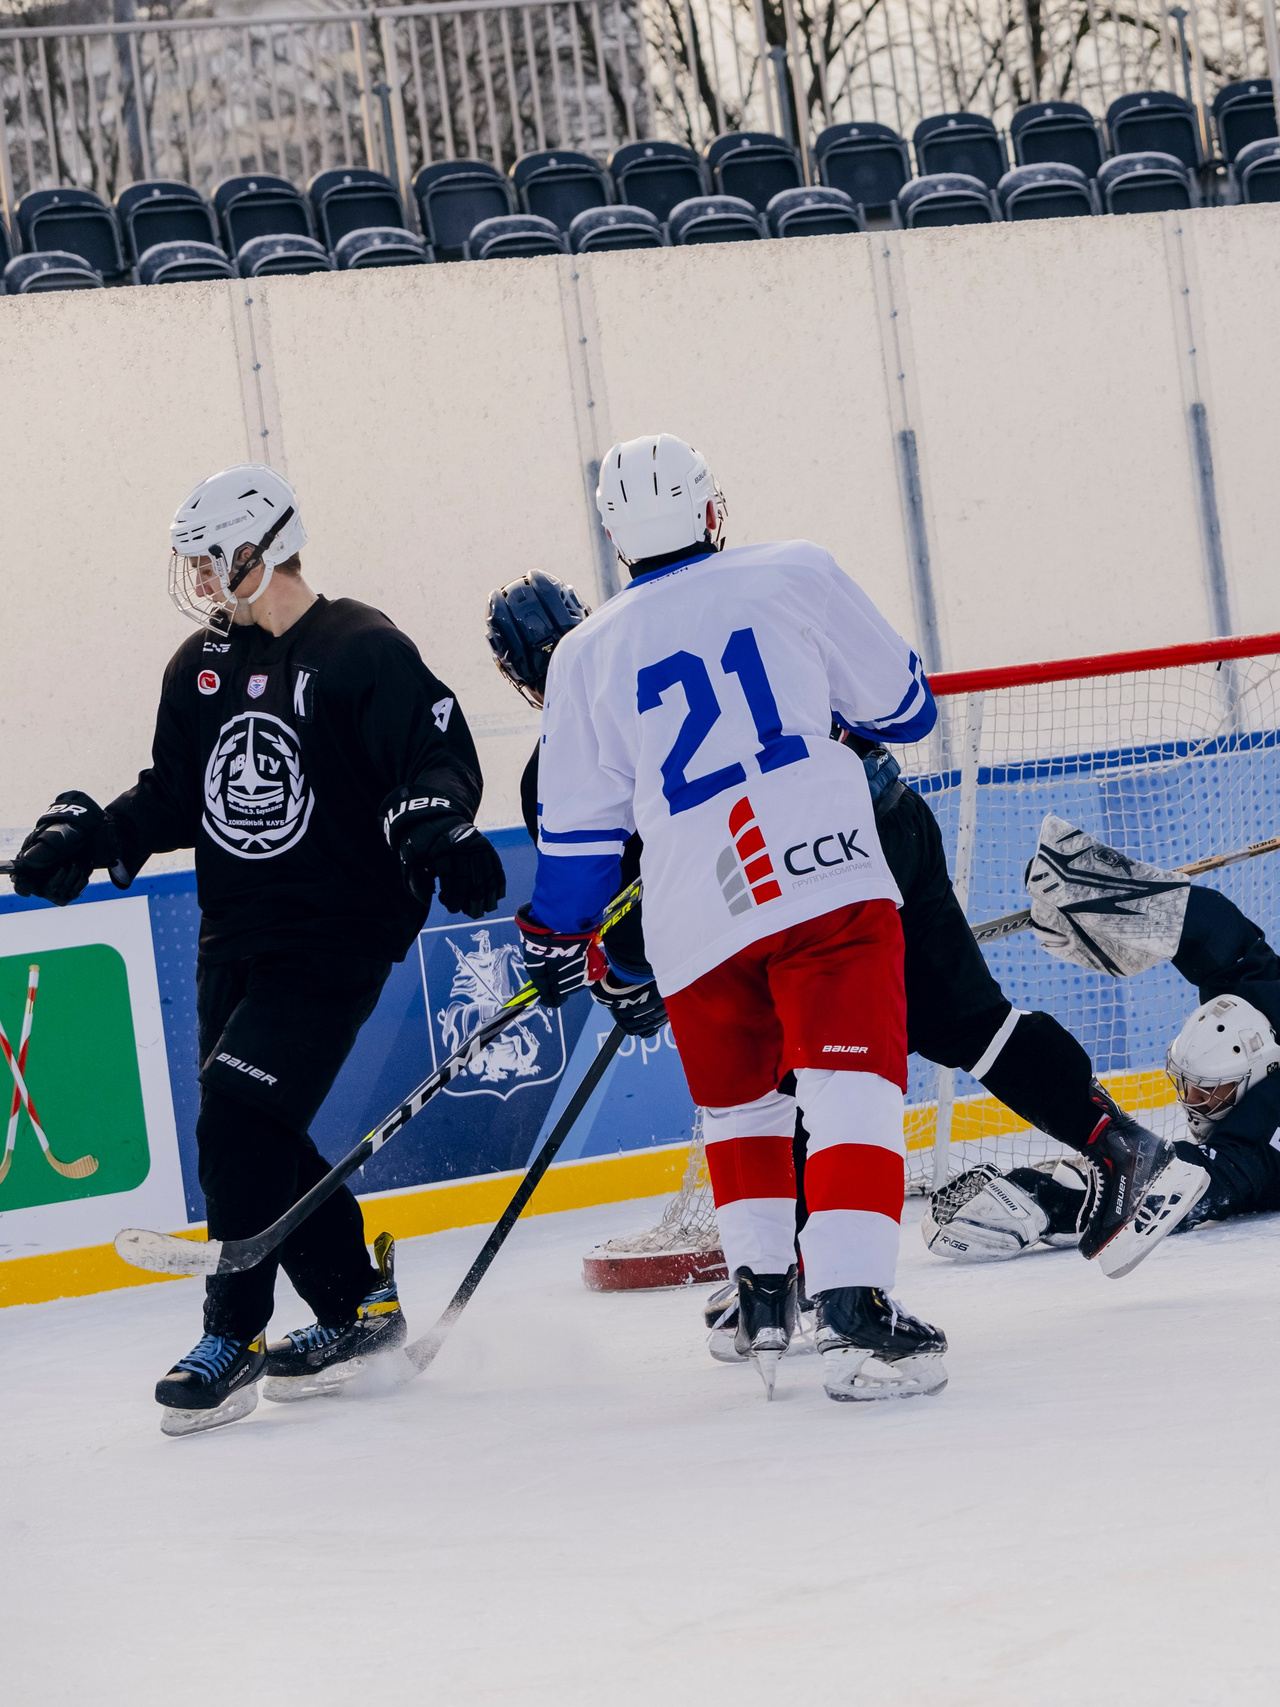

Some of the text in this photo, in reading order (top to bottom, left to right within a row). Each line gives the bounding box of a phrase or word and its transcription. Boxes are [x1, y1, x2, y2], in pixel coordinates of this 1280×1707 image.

[636, 627, 811, 817] 21
[791, 872, 829, 890] ГРУППА
[822, 1045, 869, 1054] BAUER
[215, 1052, 278, 1086] BAUER
[367, 1034, 481, 1155] CCM
[1115, 1174, 1128, 1216] BAUER
